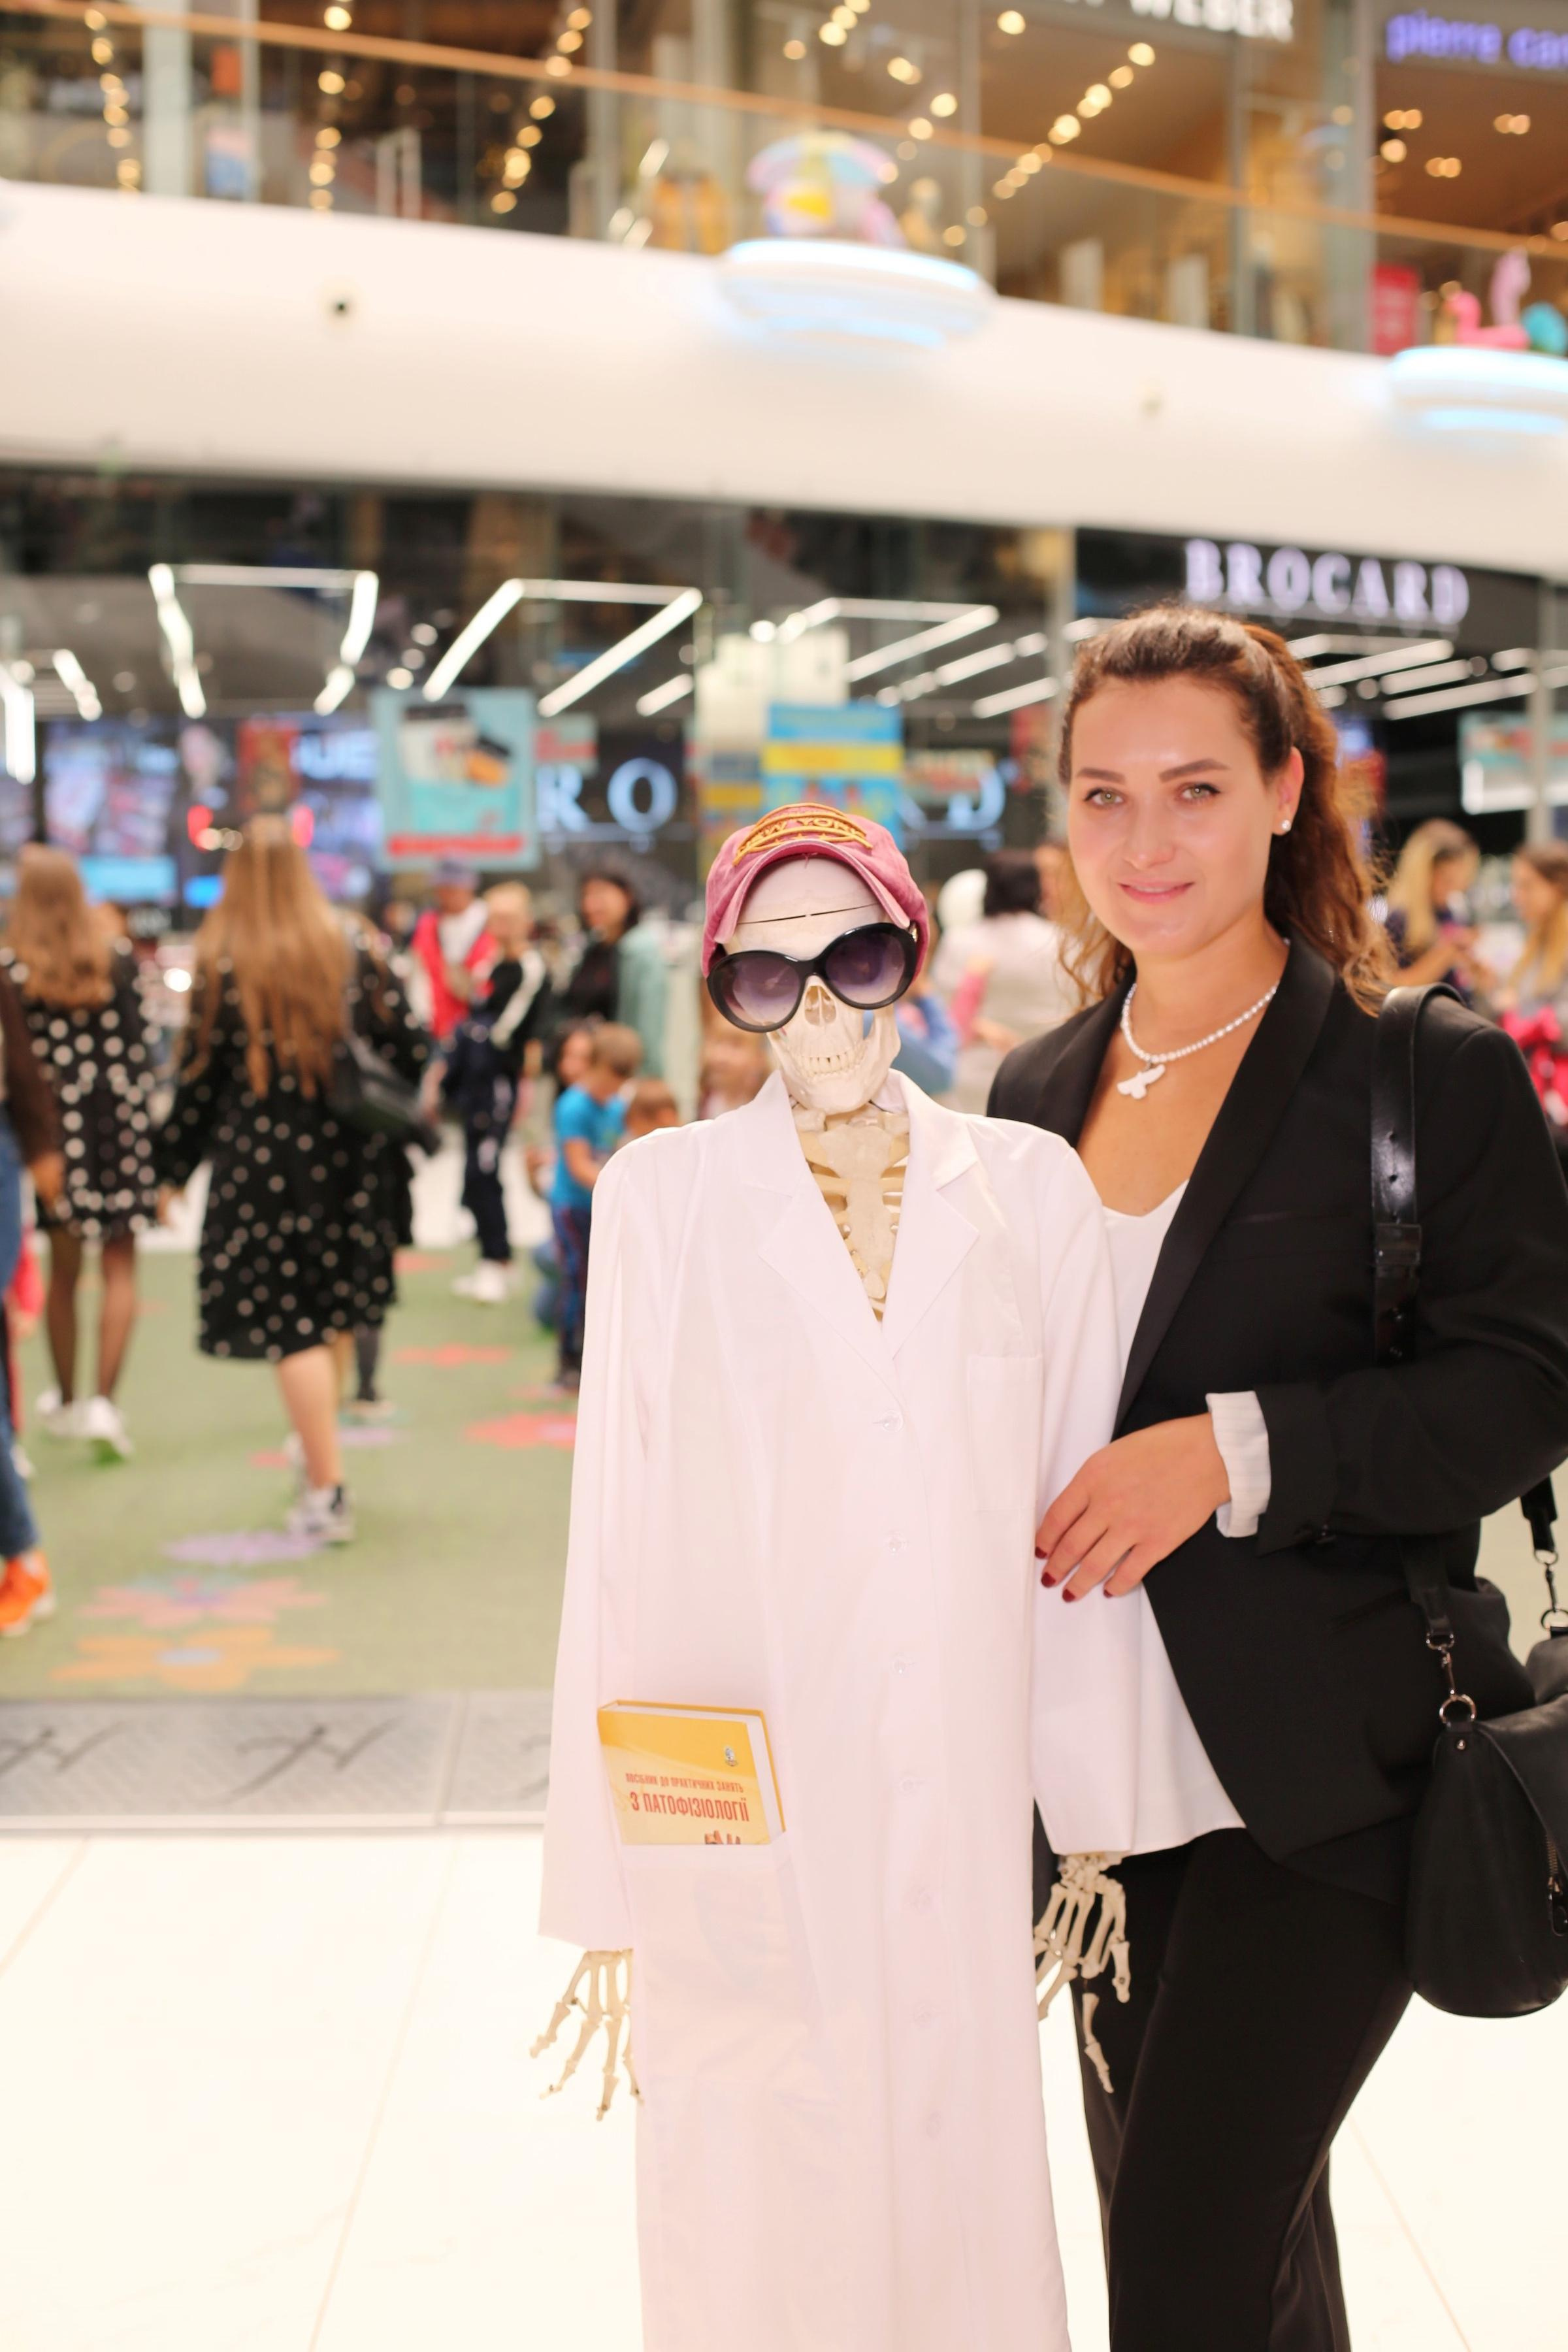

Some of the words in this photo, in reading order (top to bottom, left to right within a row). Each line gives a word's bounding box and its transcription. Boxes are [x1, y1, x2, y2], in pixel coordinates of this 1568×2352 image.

[1185, 538, 1470, 625] BROCARD
[630, 1791, 640, 1812] З
[643, 1792, 749, 1822] ПАТОФІЗІОЛОГІЇ
